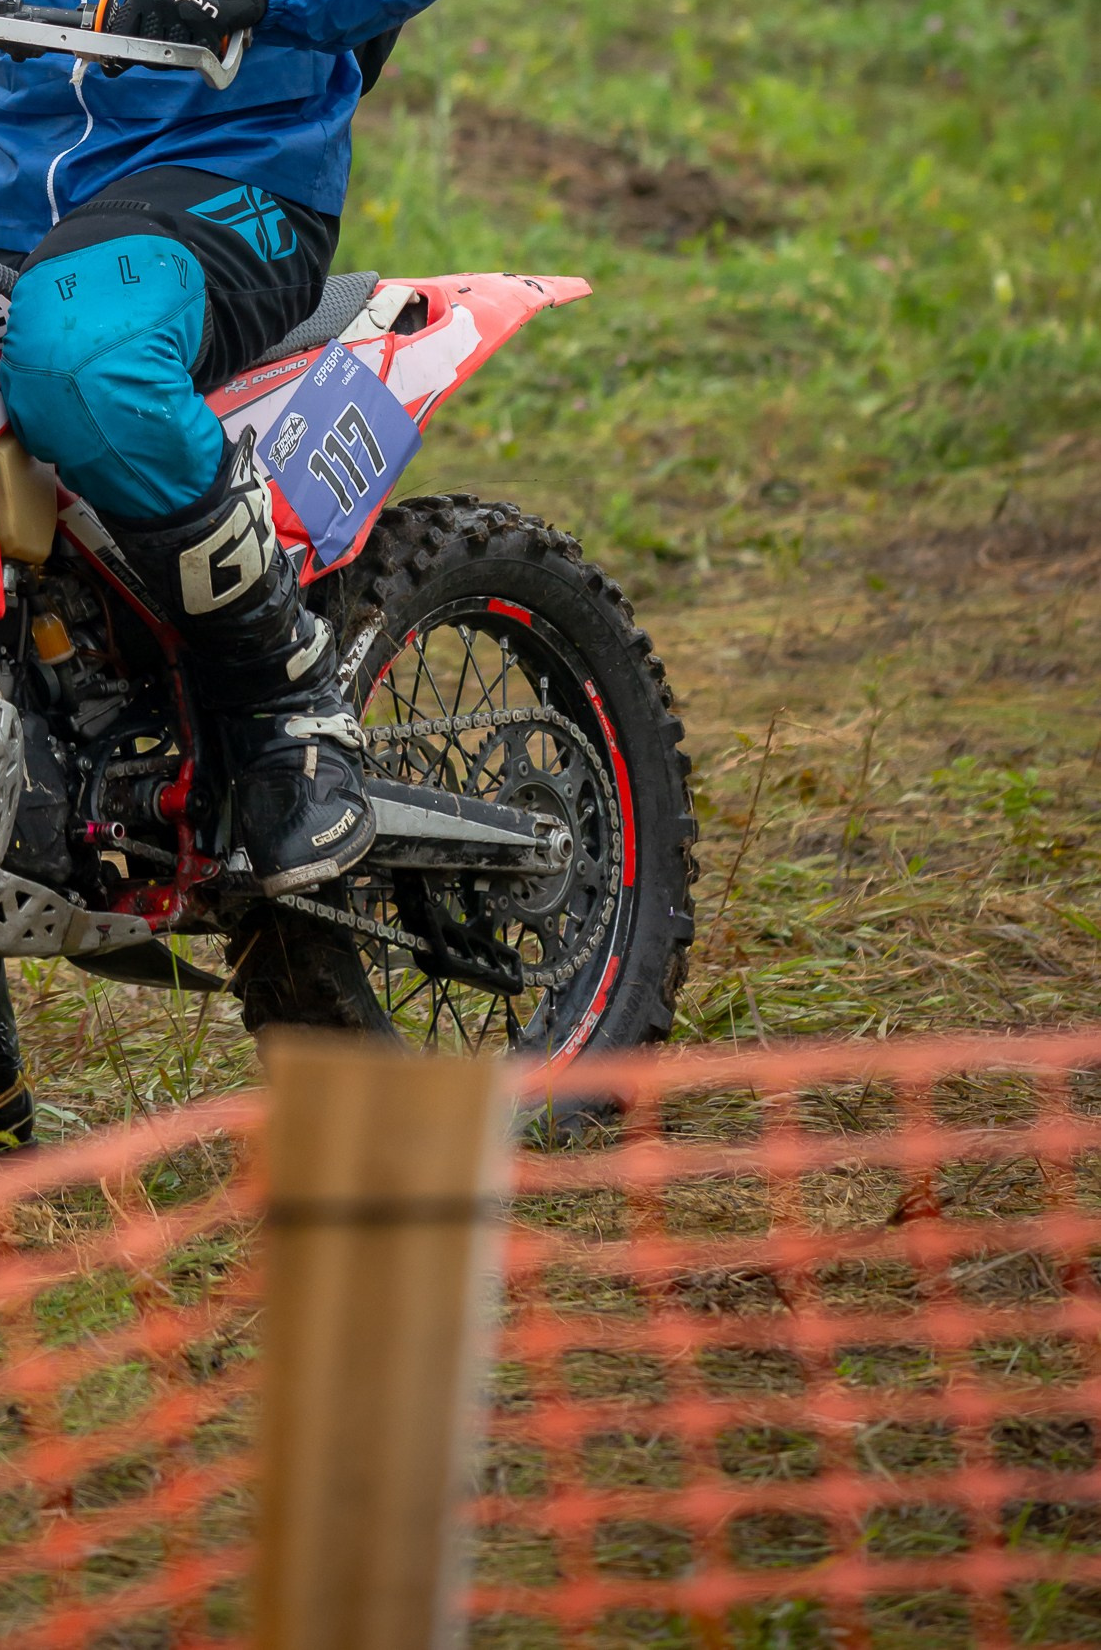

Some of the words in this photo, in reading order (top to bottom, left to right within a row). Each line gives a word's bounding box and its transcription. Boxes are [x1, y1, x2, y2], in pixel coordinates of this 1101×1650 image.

[252, 358, 308, 385] ENDURO
[313, 346, 345, 387] СЕРЕБРО
[341, 364, 360, 386] САМАРА
[307, 401, 387, 516] 117
